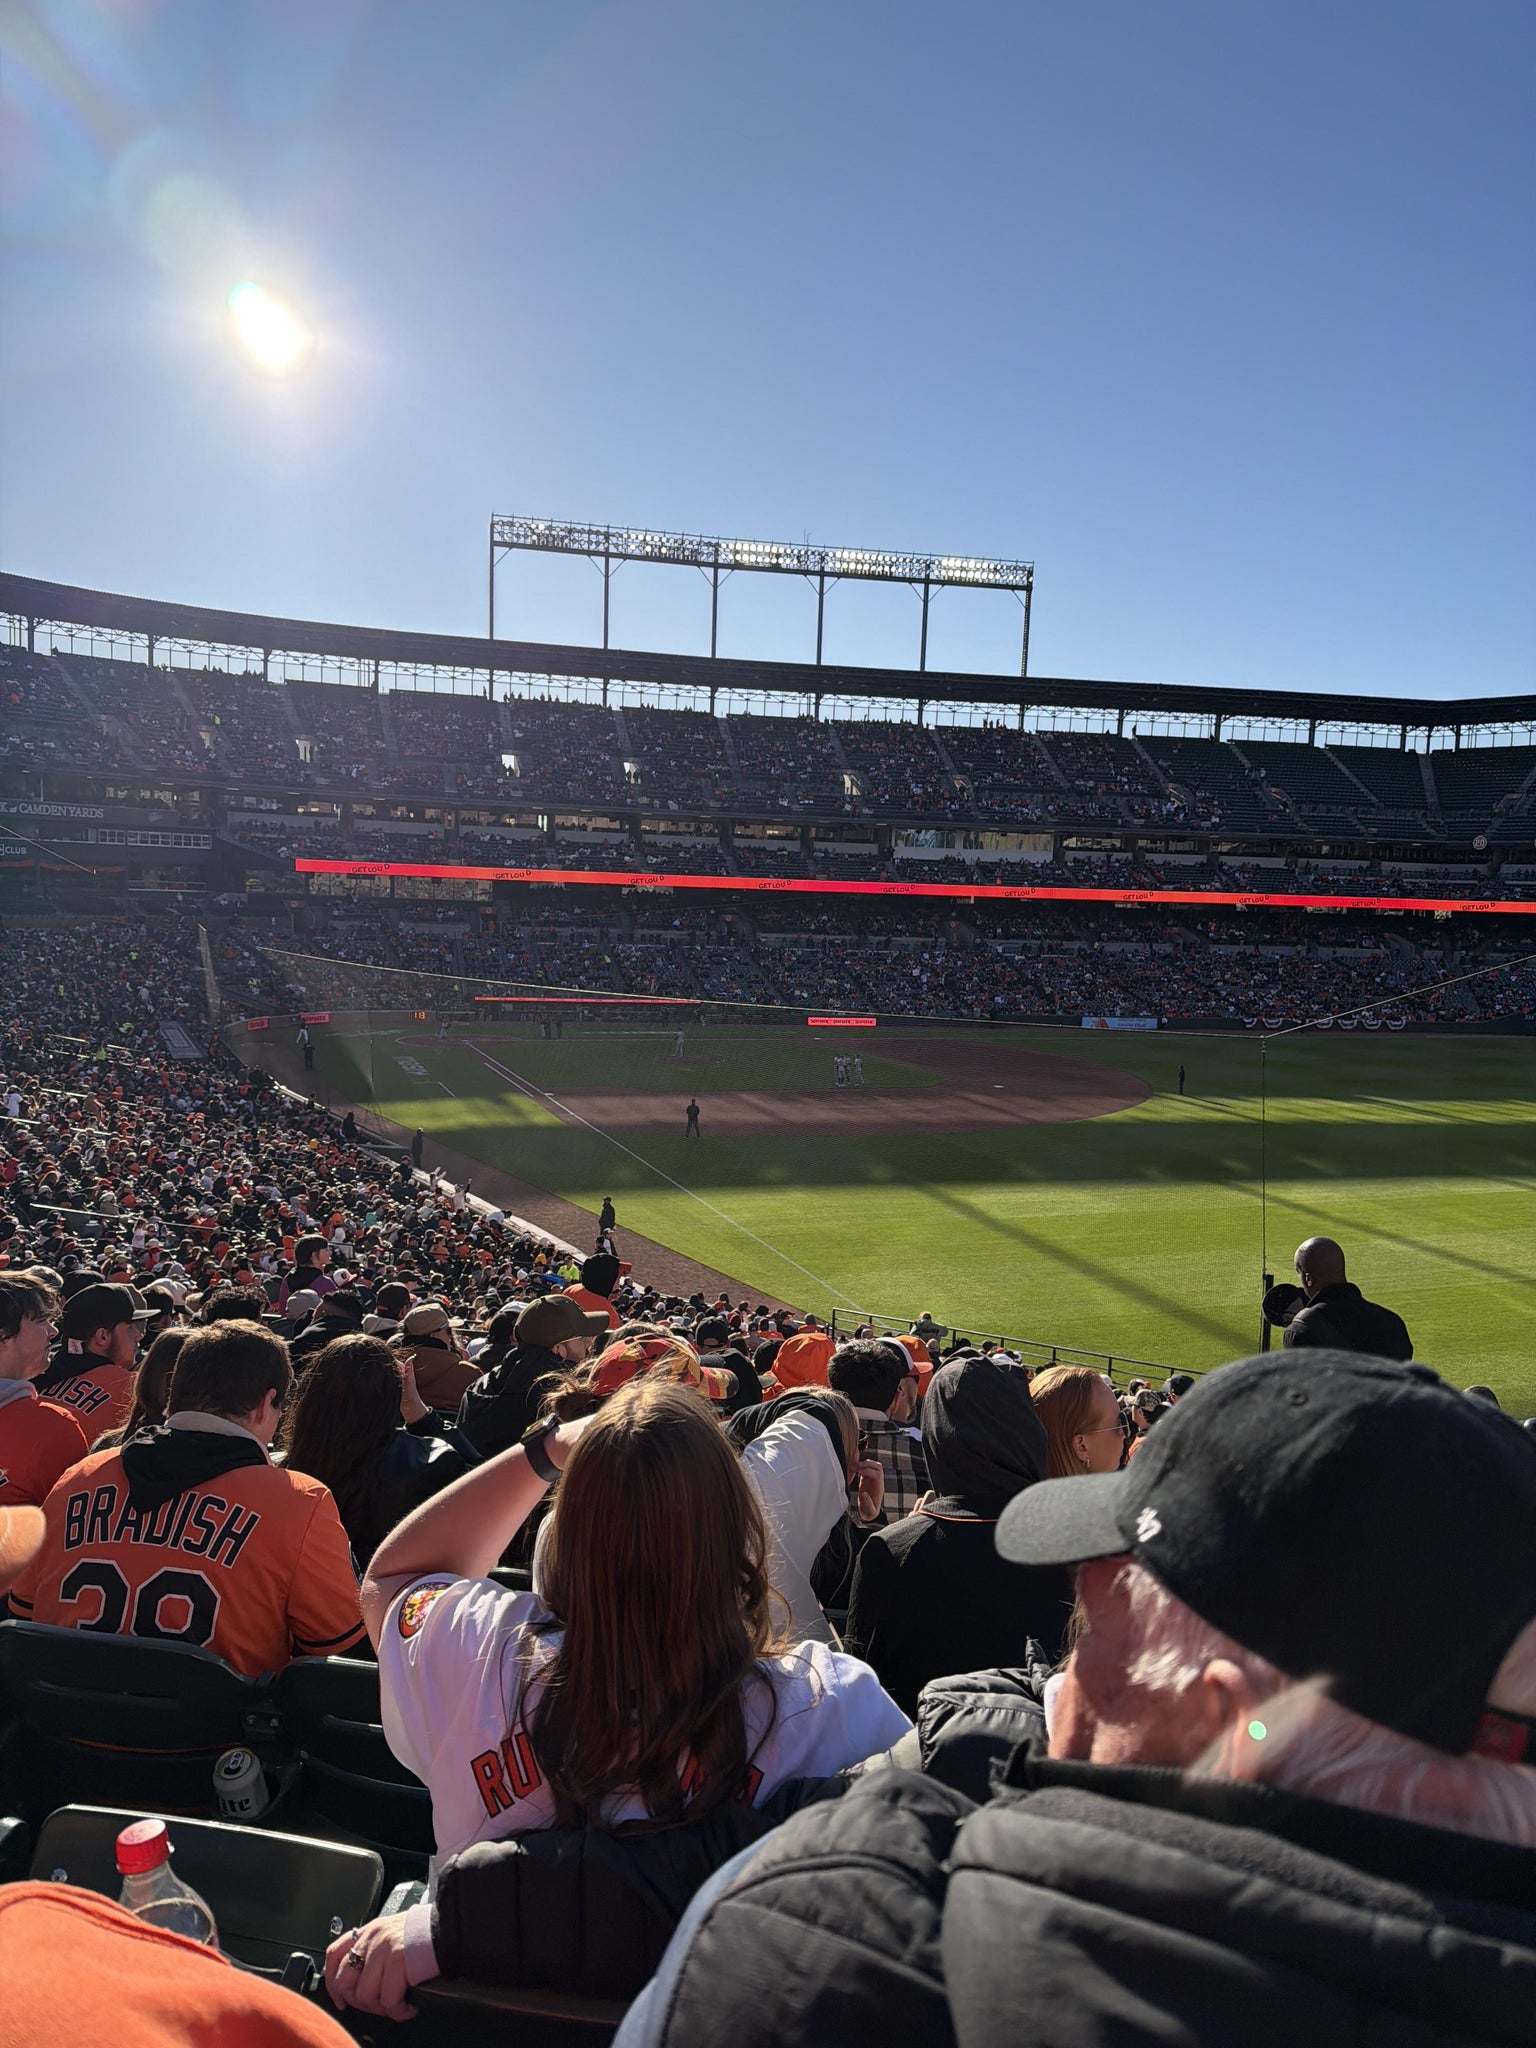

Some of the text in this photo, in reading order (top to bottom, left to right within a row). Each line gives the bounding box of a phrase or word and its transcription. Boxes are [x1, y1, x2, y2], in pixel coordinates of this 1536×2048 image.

[19, 803, 67, 817] CAMDEN
[67, 806, 104, 818] YARDS
[5, 846, 27, 854] CLUB
[64, 1483, 262, 1569] BRADISH
